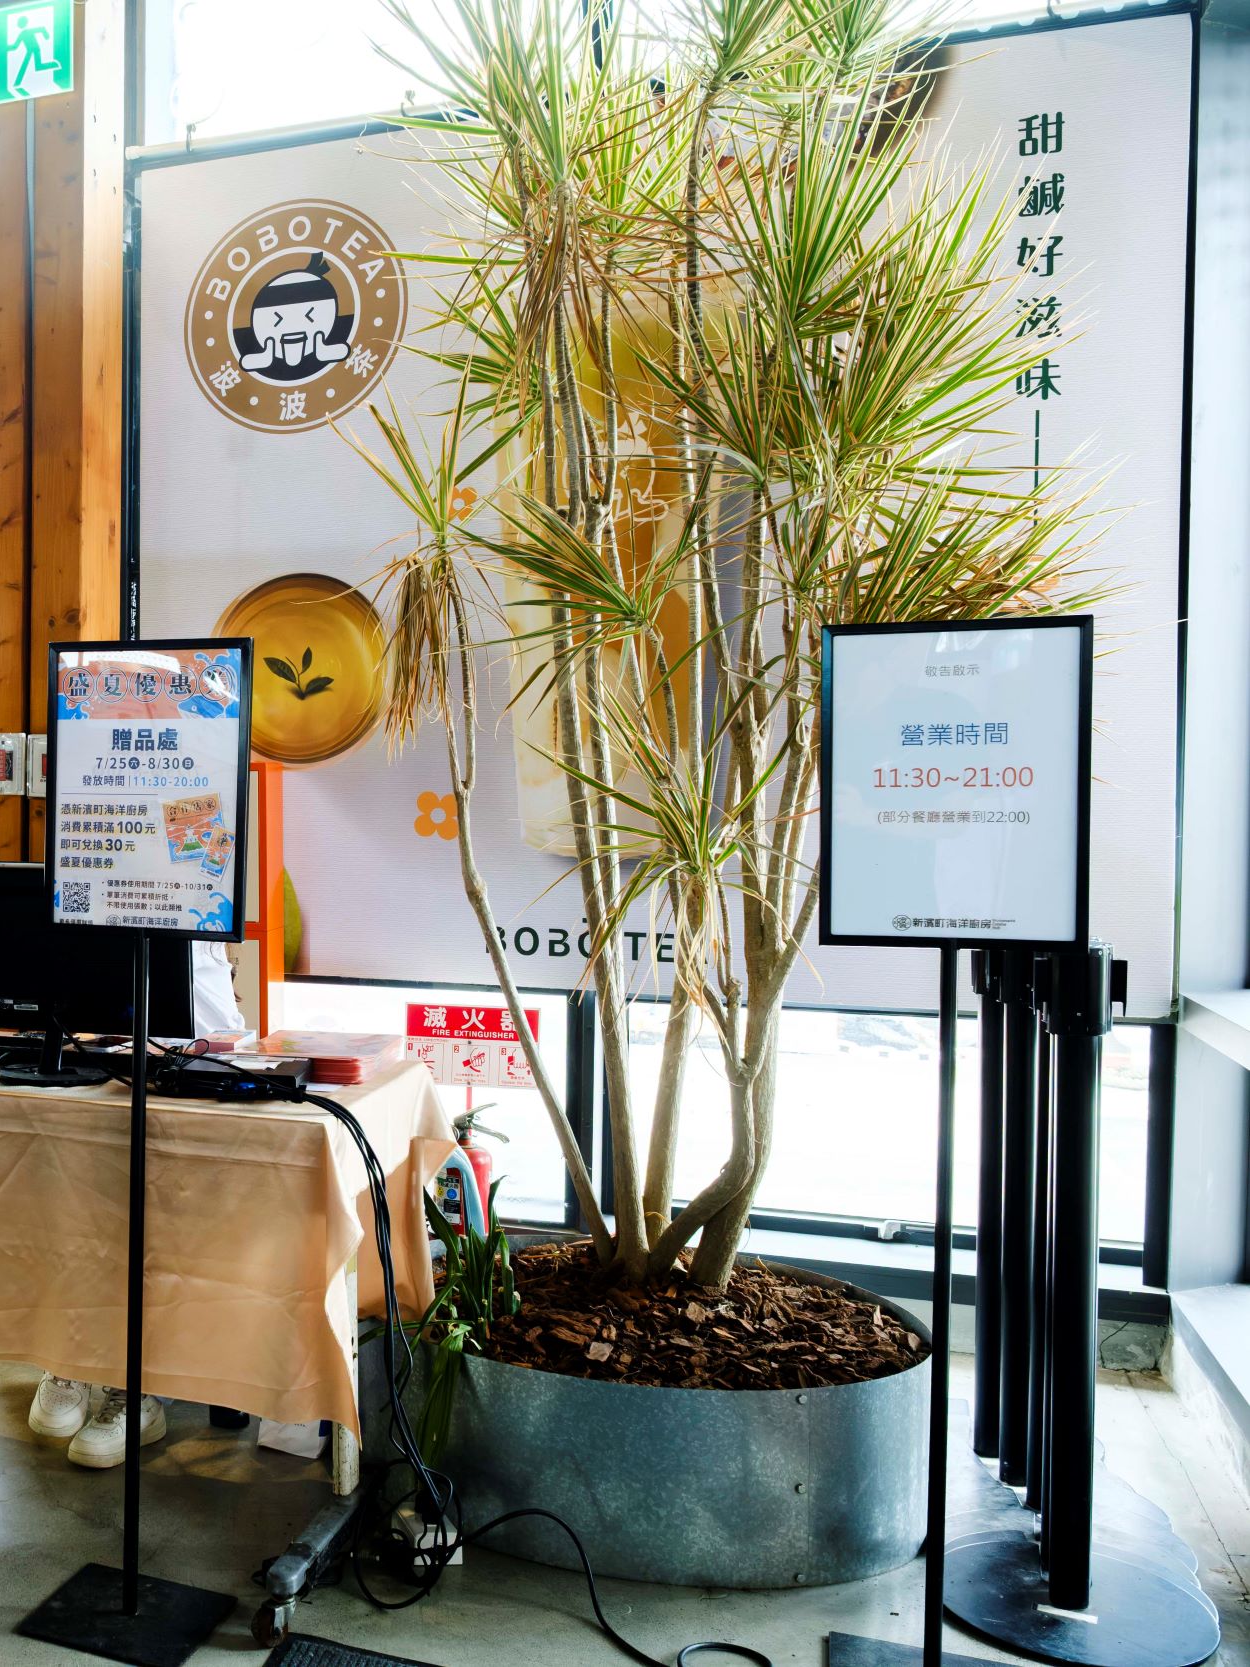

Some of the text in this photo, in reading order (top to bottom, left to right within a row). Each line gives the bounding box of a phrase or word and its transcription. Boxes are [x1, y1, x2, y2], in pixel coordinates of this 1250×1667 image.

[111, 728, 178, 751] 贈品處
[900, 722, 1009, 746] 營業時間
[82, 775, 209, 787] 發放時間 11:30-20:00
[873, 766, 1034, 788] 11:30~21:00
[877, 810, 1031, 824] (部分餐廳營業到22:00)
[423, 1006, 516, 1031] 滅火器
[432, 1028, 514, 1039] FIRE EXTINGUISHER
